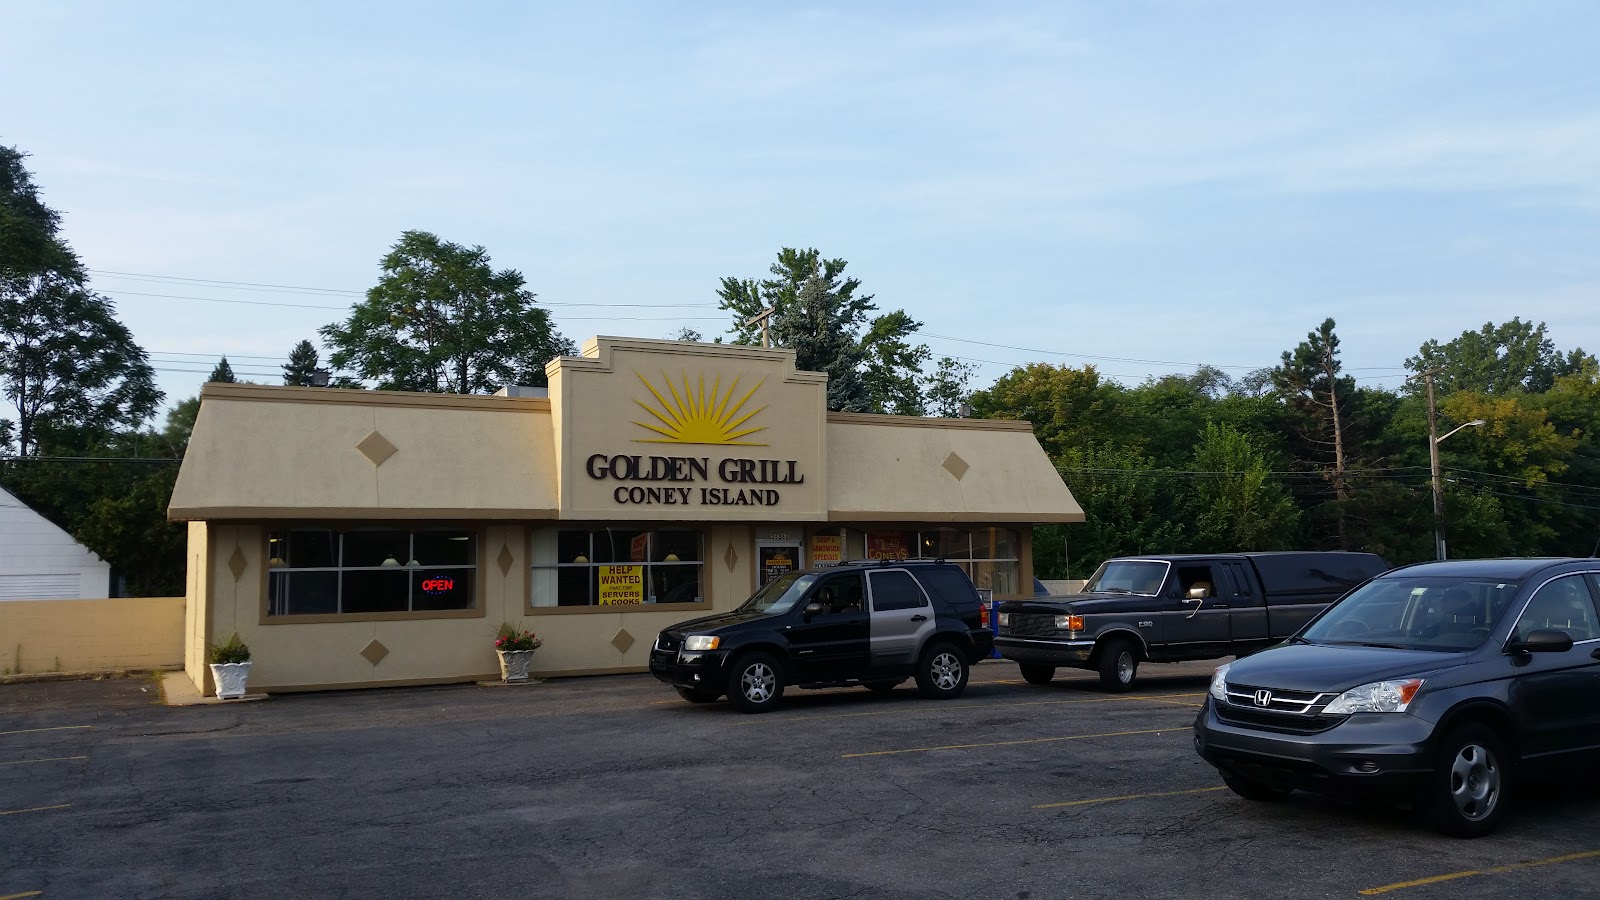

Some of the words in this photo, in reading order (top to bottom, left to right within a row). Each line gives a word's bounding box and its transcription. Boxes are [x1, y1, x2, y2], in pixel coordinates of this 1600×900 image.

[586, 453, 709, 481] GOLDEN
[718, 458, 804, 485] GRILL
[613, 486, 692, 505] CONEY
[700, 487, 780, 506] ISLAND
[816, 536, 830, 544] SOUP
[813, 553, 839, 561] SPECIALS
[609, 565, 633, 575] HELP
[422, 579, 453, 591] OPEN
[601, 575, 641, 585] WANTED
[611, 598, 640, 606] COOKS
